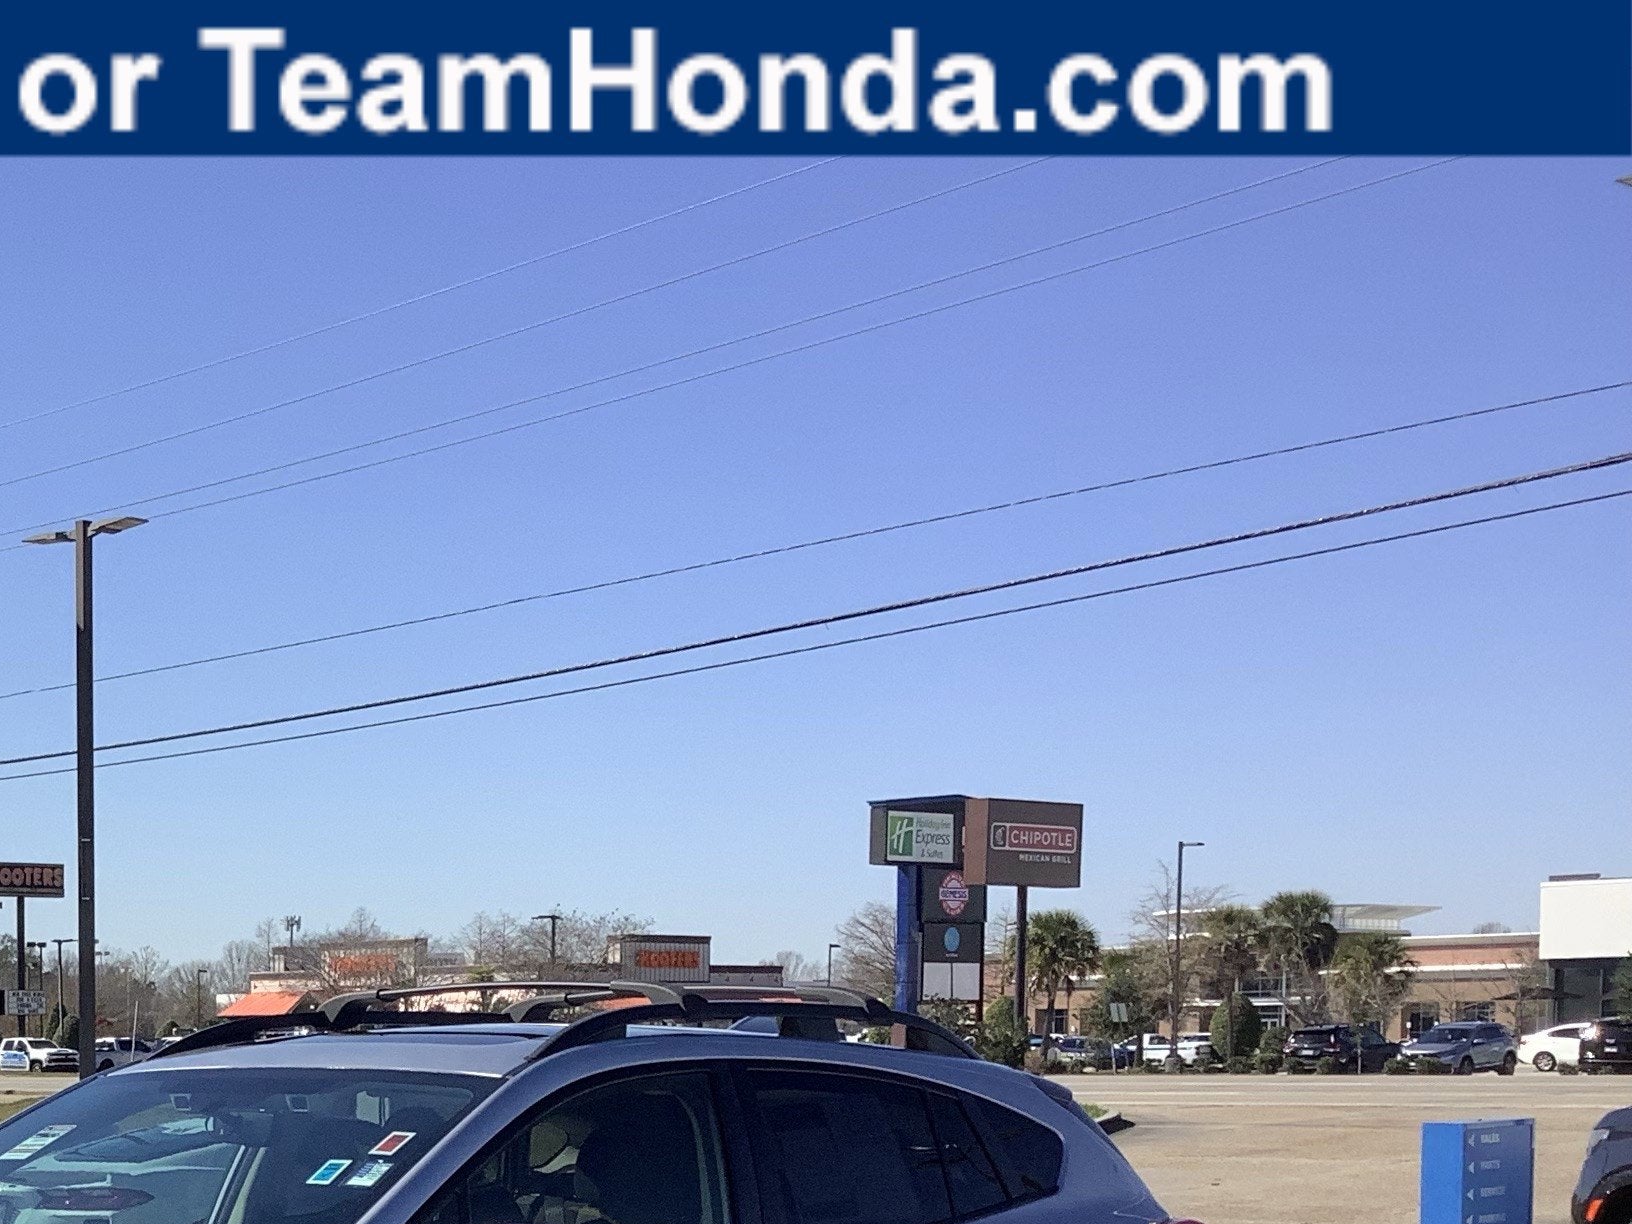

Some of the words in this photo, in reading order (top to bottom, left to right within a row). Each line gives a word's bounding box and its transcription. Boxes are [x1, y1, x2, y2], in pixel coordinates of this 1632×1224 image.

[915, 829, 951, 847] Express
[1010, 830, 1072, 847] CHIPOTLE
[1019, 854, 1050, 862] MEXICAN
[1052, 856, 1071, 864] GRILL
